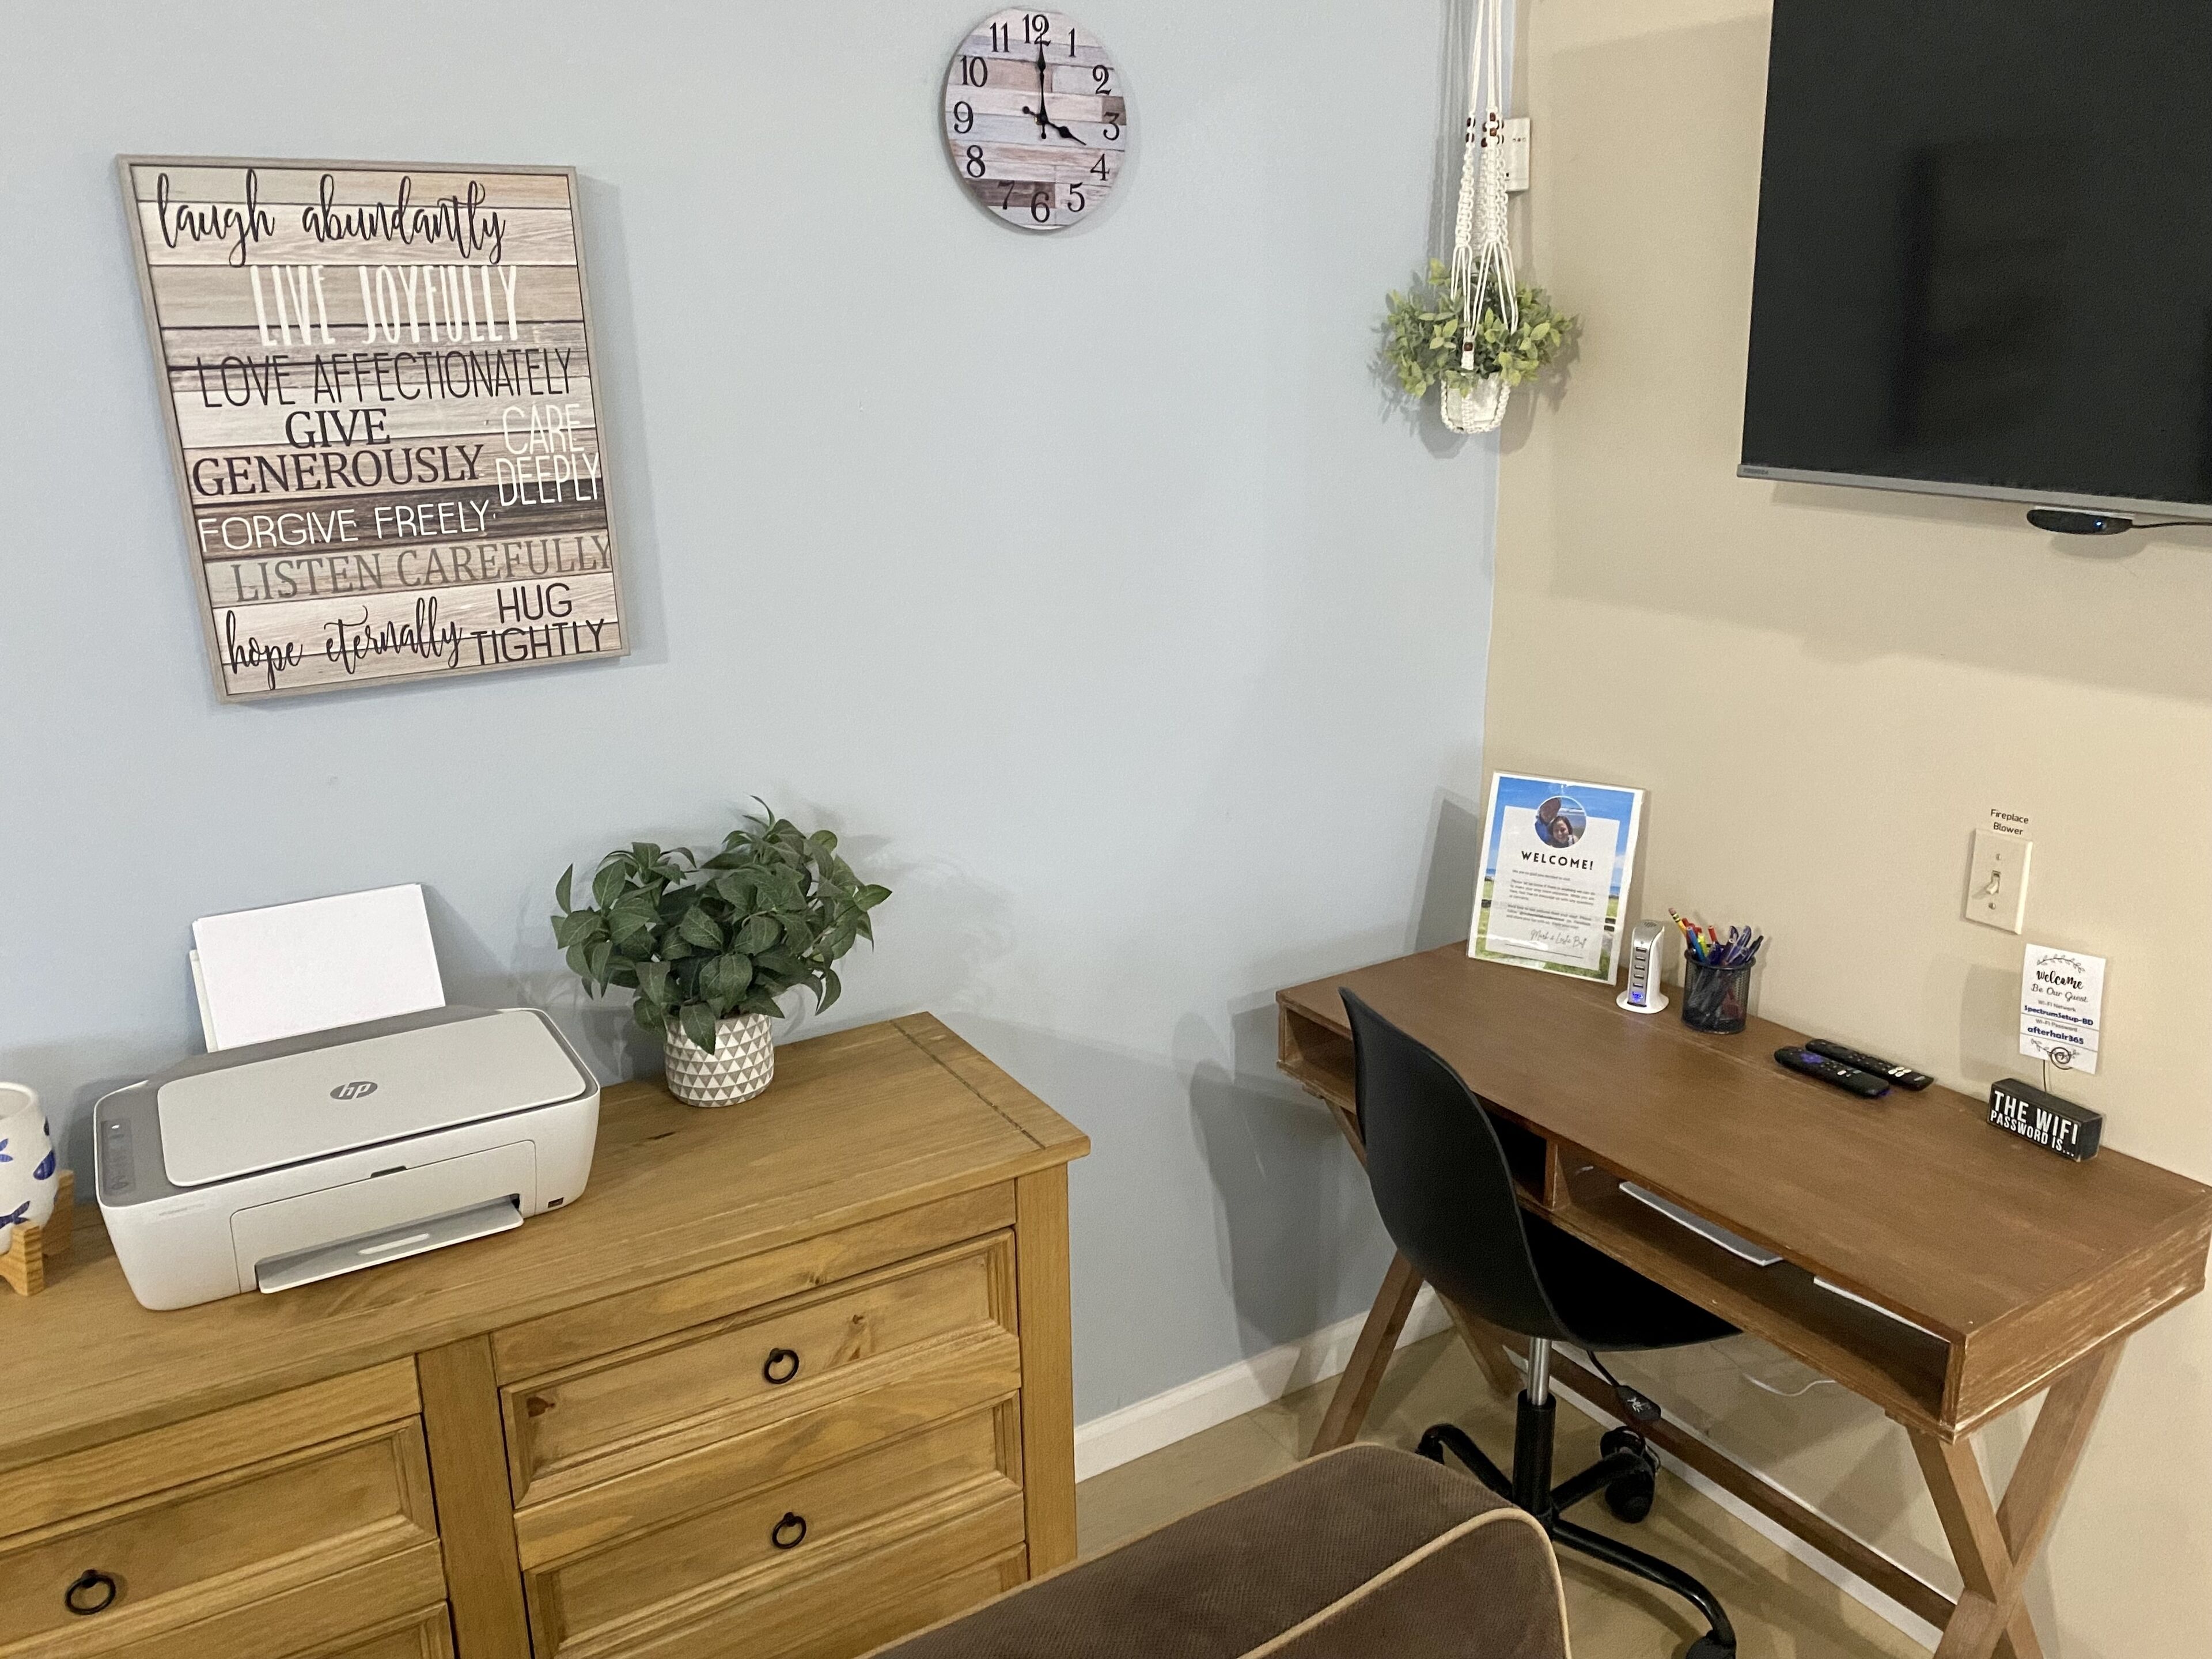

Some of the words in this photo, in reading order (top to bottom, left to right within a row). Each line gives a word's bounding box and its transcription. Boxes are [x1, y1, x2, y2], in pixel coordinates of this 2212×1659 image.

[990, 22, 1010, 52] 11
[1022, 13, 1051, 46] 12
[1068, 28, 1076, 57] 1
[960, 55, 988, 88] 10
[1092, 65, 1112, 96] 2
[953, 101, 974, 134] 9
[1103, 112, 1120, 141] 3
[966, 145, 986, 178] 8
[1090, 153, 1109, 181] 4
[997, 180, 1015, 210] 7
[1031, 191, 1050, 223] 6
[1067, 182, 1085, 212] 5
[158, 168, 274, 267] laugh
[302, 174, 506, 264] abundantly
[250, 265, 335, 346] LIVE
[359, 265, 518, 344] JOYFULLY
[197, 354, 296, 408] LOVE
[313, 347, 571, 405] AFFECTIONATELY
[285, 408, 391, 448] GIVE
[502, 403, 585, 455] CARE
[192, 444, 485, 496] GENEROUSLY
[496, 453, 600, 507] DEEPLY
[197, 509, 358, 552] FORGIVE
[374, 499, 489, 539] FREELY
[232, 552, 381, 604] LISTEN
[397, 535, 611, 589] CAREFULLY
[497, 582, 573, 623] HUG
[225, 600, 302, 690] hope
[324, 597, 462, 677] eternally
[471, 618, 605, 666] TIGHTLY
[1990, 809, 2029, 824] Fireplace
[1993, 822, 2023, 835] Blower
[1521, 850, 1593, 870] WELCOME!
[2031, 983, 2043, 992] Be
[2047, 987, 2062, 997] Our
[2065, 991, 2088, 1002] Guest
[2024, 1005, 2093, 1025] SpectrumSetup-BD
[338, 1082, 372, 1100] hp
[1990, 1109, 2048, 1145] PASSWORD
[2051, 1136, 2074, 1157] IS...
[1994, 1090, 2029, 1123] THE
[2036, 1108, 2078, 1145] WIFI
